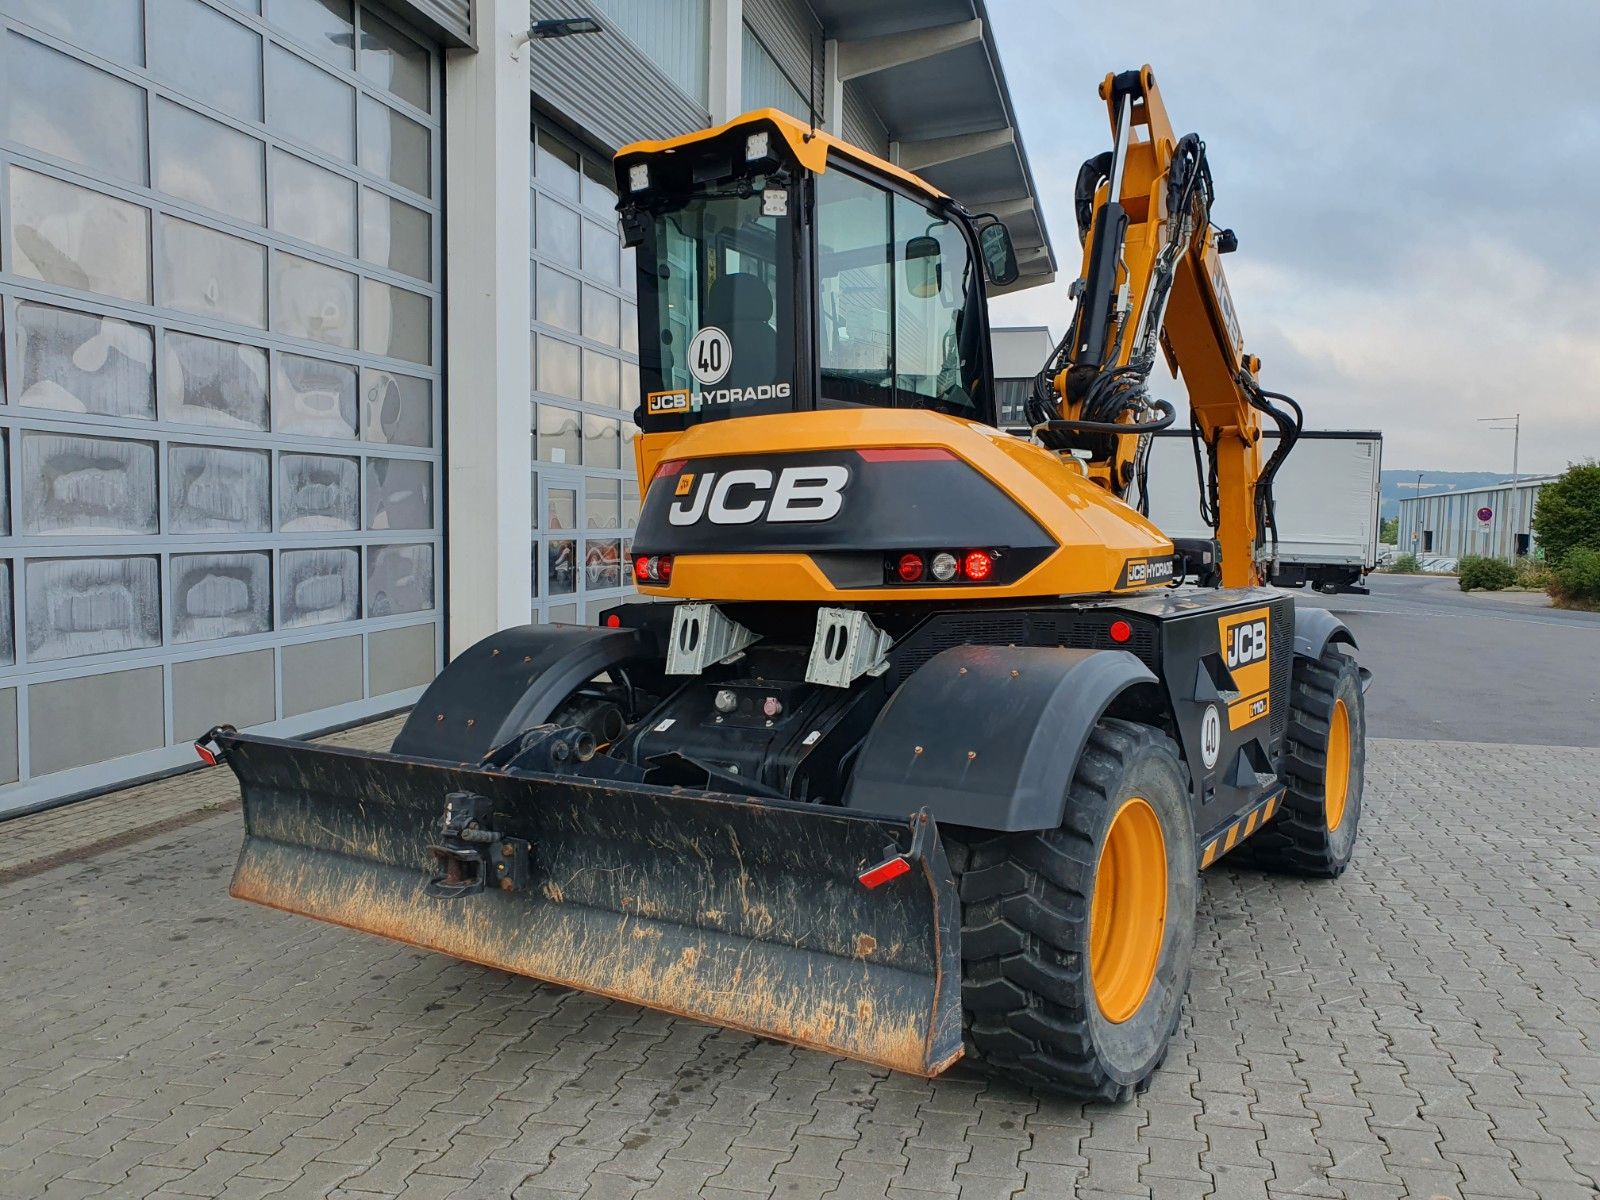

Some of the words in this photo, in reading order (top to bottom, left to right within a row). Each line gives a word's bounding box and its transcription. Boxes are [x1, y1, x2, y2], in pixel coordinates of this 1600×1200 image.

[698, 338, 722, 373] 40
[651, 394, 686, 410] JCB
[691, 383, 791, 406] HYDRADIG
[669, 466, 849, 526] JCB
[1129, 564, 1145, 581] JCB
[1227, 621, 1266, 668] JCB
[1206, 717, 1216, 756] 40
